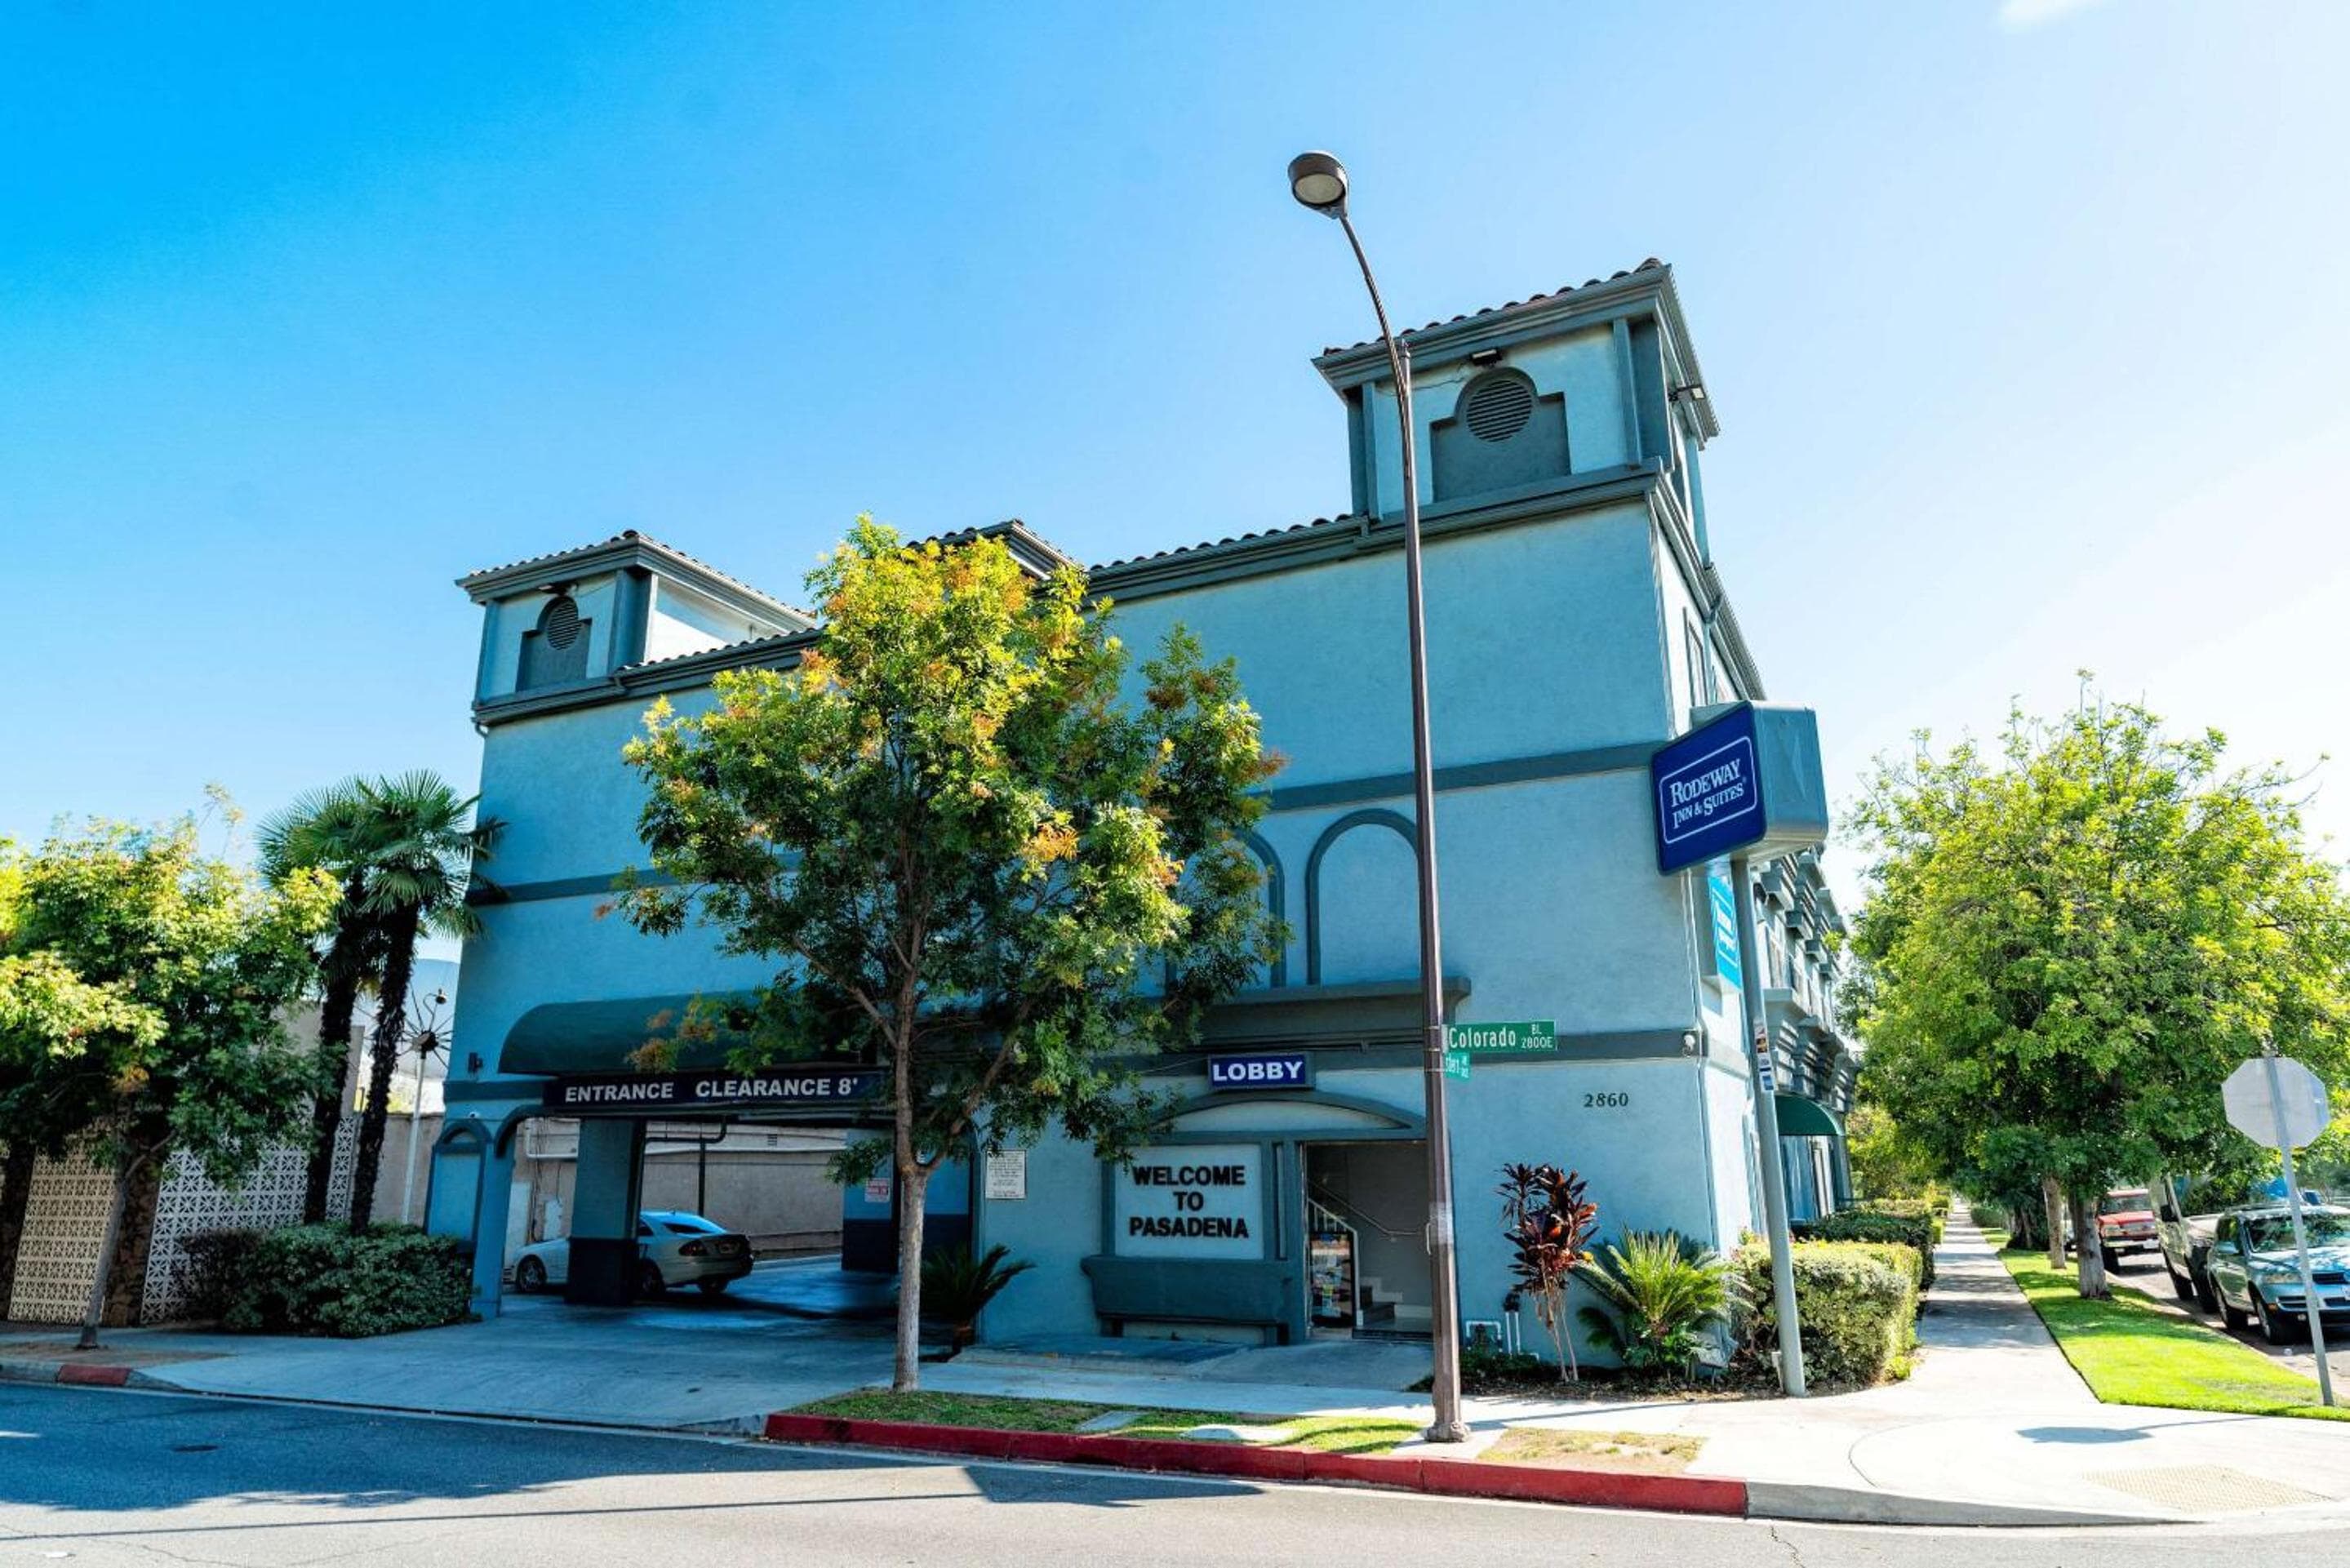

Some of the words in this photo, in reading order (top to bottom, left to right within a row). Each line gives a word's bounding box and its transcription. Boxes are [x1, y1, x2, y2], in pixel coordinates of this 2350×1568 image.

[1670, 758, 1740, 807] RODEWAY
[1673, 805, 1693, 829] INN
[1695, 802, 1703, 815] &
[1704, 783, 1744, 816] SUITES
[1449, 1027, 1517, 1049] Colorado
[1532, 1024, 1542, 1035] BL
[1522, 1037, 1553, 1049] 2800E
[1212, 1061, 1303, 1082] LOBBY
[565, 1082, 674, 1103] ENTRANCE
[695, 1078, 831, 1097] CLEARANCE
[838, 1077, 858, 1095] 8'
[1584, 1092, 1629, 1108] 2860
[1132, 1166, 1246, 1186] WELCOME
[1174, 1191, 1204, 1211] TO
[1129, 1217, 1249, 1238] PASADENA
